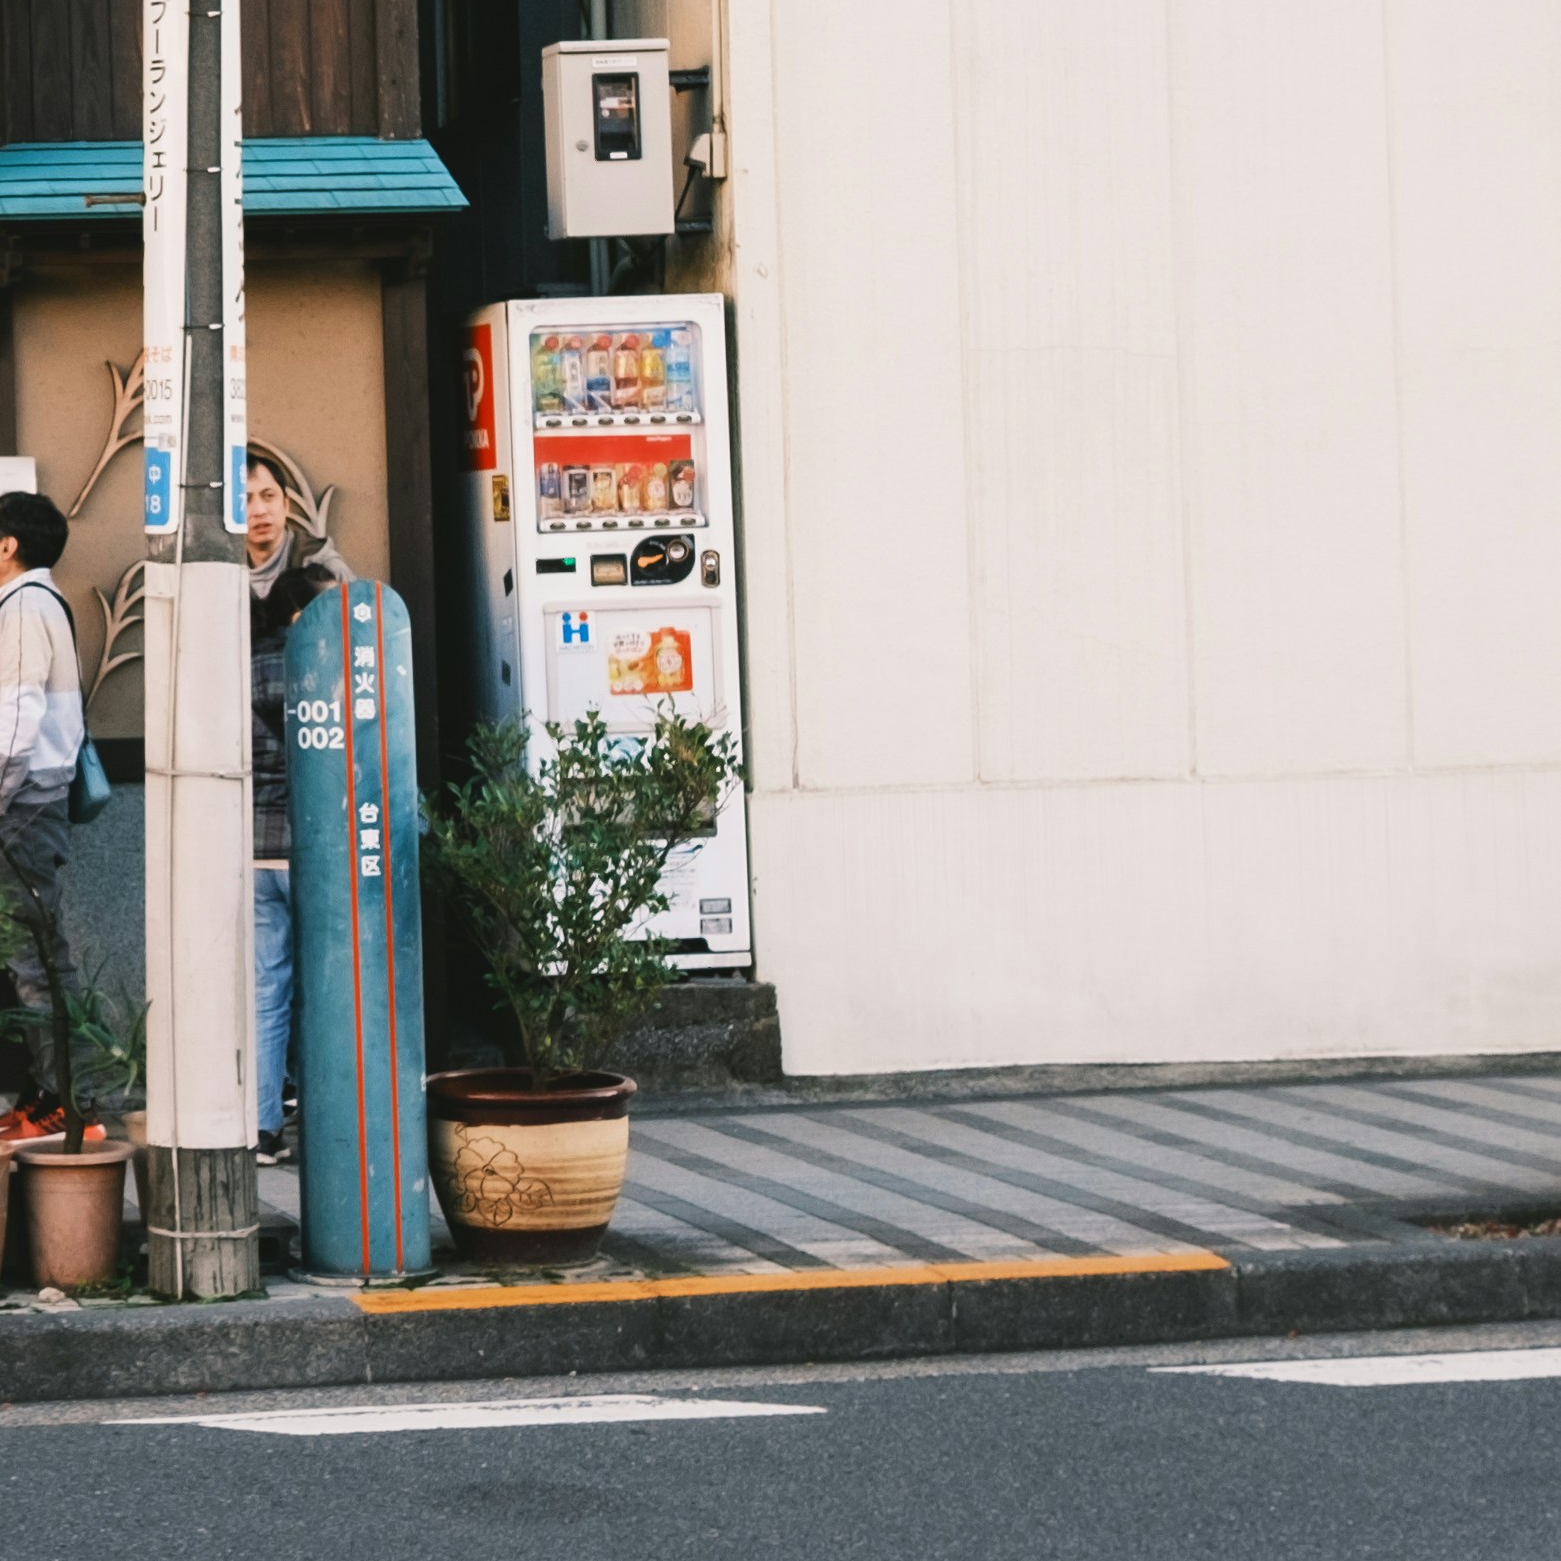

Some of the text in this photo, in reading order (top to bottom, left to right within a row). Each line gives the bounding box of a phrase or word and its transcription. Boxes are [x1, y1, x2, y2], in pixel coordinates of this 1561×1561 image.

[352, 645, 377, 720] 消火器
[297, 726, 345, 750] 002
[358, 801, 382, 878] 台東区
